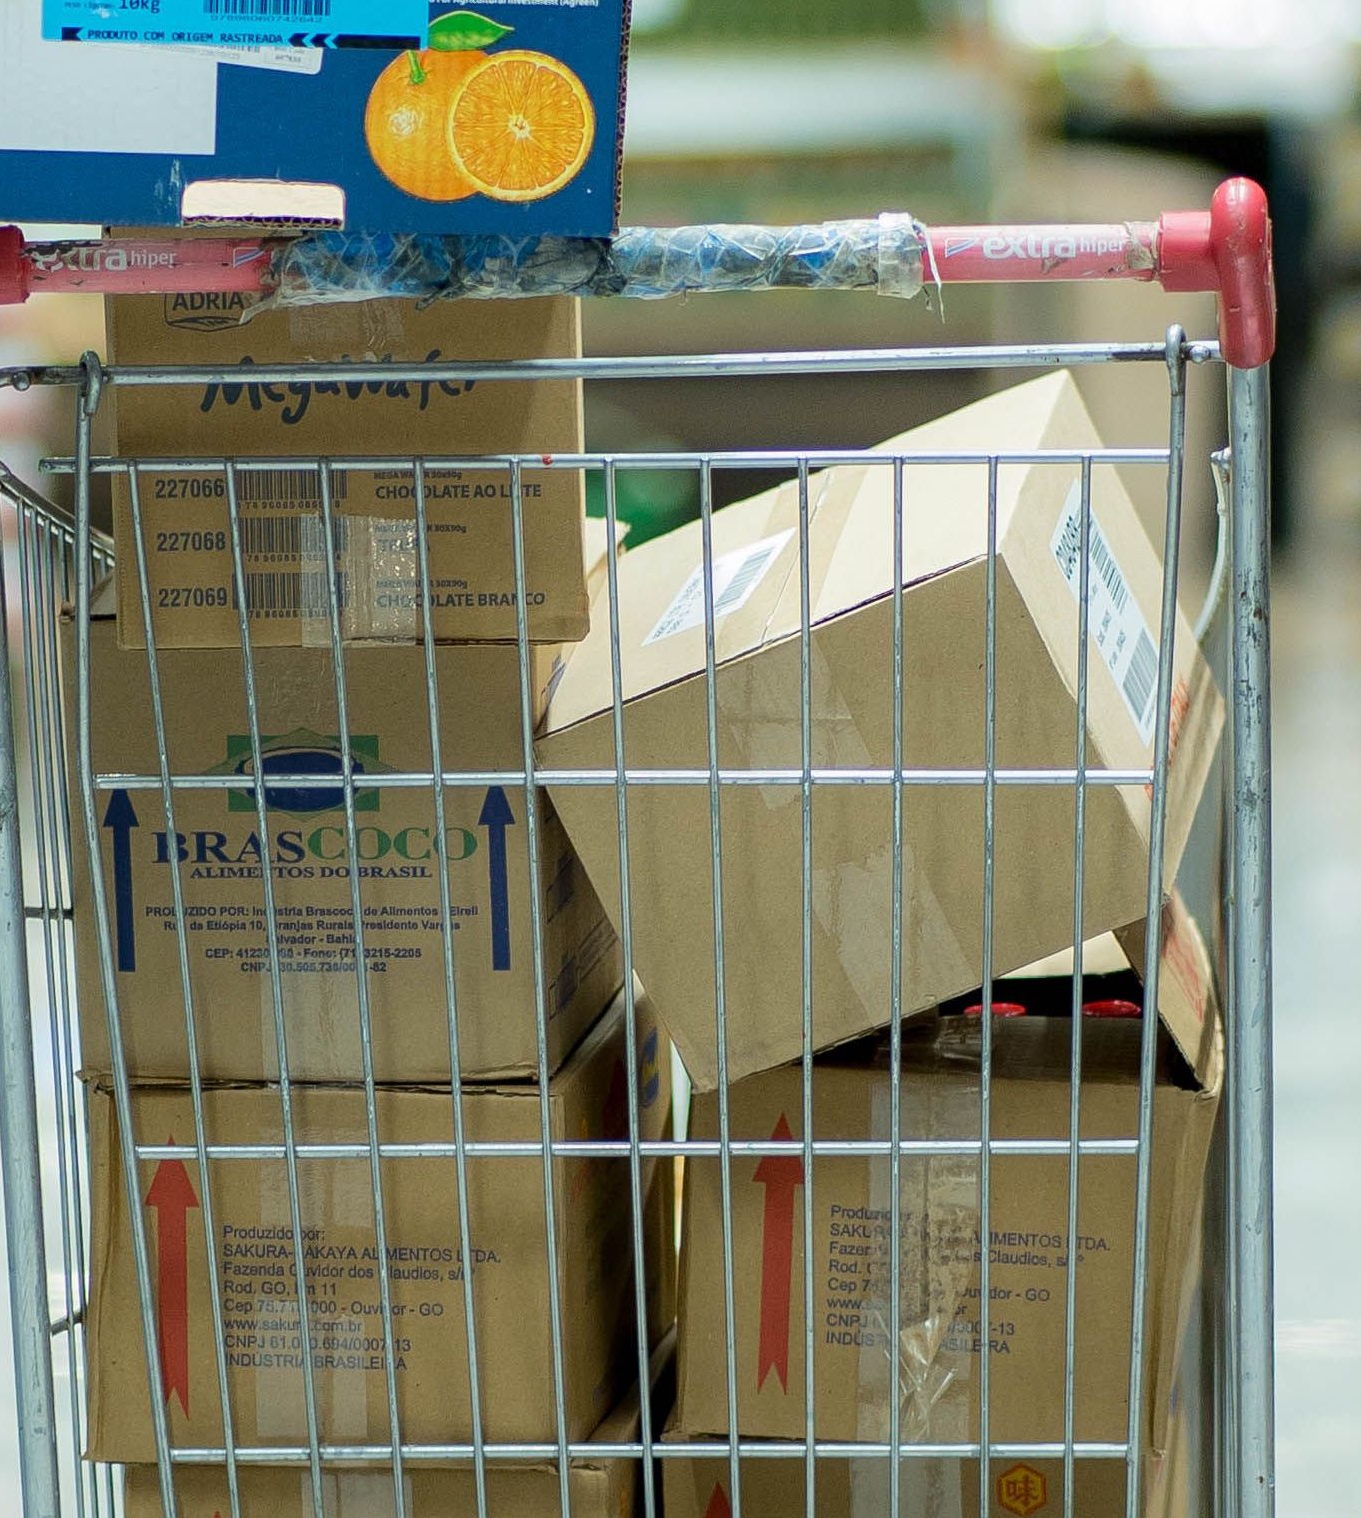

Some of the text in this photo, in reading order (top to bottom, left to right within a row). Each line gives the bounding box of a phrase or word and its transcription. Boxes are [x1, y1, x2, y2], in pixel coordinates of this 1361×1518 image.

[88, 30, 283, 44] PRODUTO COM ORIGEM RASTREADA
[983, 229, 1076, 259] extra
[131, 249, 177, 269] hiper
[155, 479, 225, 499] 227066
[473, 484, 496, 498] AO
[500, 483, 542, 498] LTE
[157, 532, 226, 551] 227068
[158, 587, 228, 608] 227069
[152, 826, 478, 864] BRASCOCO
[190, 865, 433, 879] ALIMETOS DO BRASIL
[220, 906, 249, 917] POR:
[252, 905, 303, 917] Instria
[306, 905, 359, 917] Brascoc
[364, 905, 378, 916] de
[380, 906, 439, 917] Alimentos
[190, 920, 204, 931] da
[269, 921, 313, 934] ranjas
[266, 935, 316, 945] alvador
[205, 949, 234, 959] CEP:
[339, 949, 362, 960] (71
[223, 1225, 295, 1240] Produzido
[974, 1231, 1062, 1248] IMENTOS
[1067, 1236, 1111, 1251] TDA.
[223, 1243, 358, 1260] SAKURA-AKAYA
[361, 1246, 453, 1262] ALMENTOS
[989, 1250, 1052, 1268] Claudios,
[223, 1261, 285, 1276] Fazenda
[348, 1265, 374, 1279] dos
[380, 1266, 443, 1282] laudios,
[828, 1259, 862, 1274] Rod.
[224, 1281, 257, 1295] Rod.
[321, 1282, 337, 1296] 11
[827, 1277, 857, 1294] Cep
[958, 1286, 1012, 1301] uvdor
[1025, 1288, 1050, 1301] GO
[224, 1299, 253, 1315] Cep
[350, 1301, 407, 1316] Ouvior
[419, 1302, 444, 1317] GO
[224, 1319, 362, 1332] www.sakur.com.br
[826, 1313, 868, 1328] CNPJ
[224, 1335, 266, 1349] CNPJ
[314, 1355, 407, 1370] BRASILEIA
